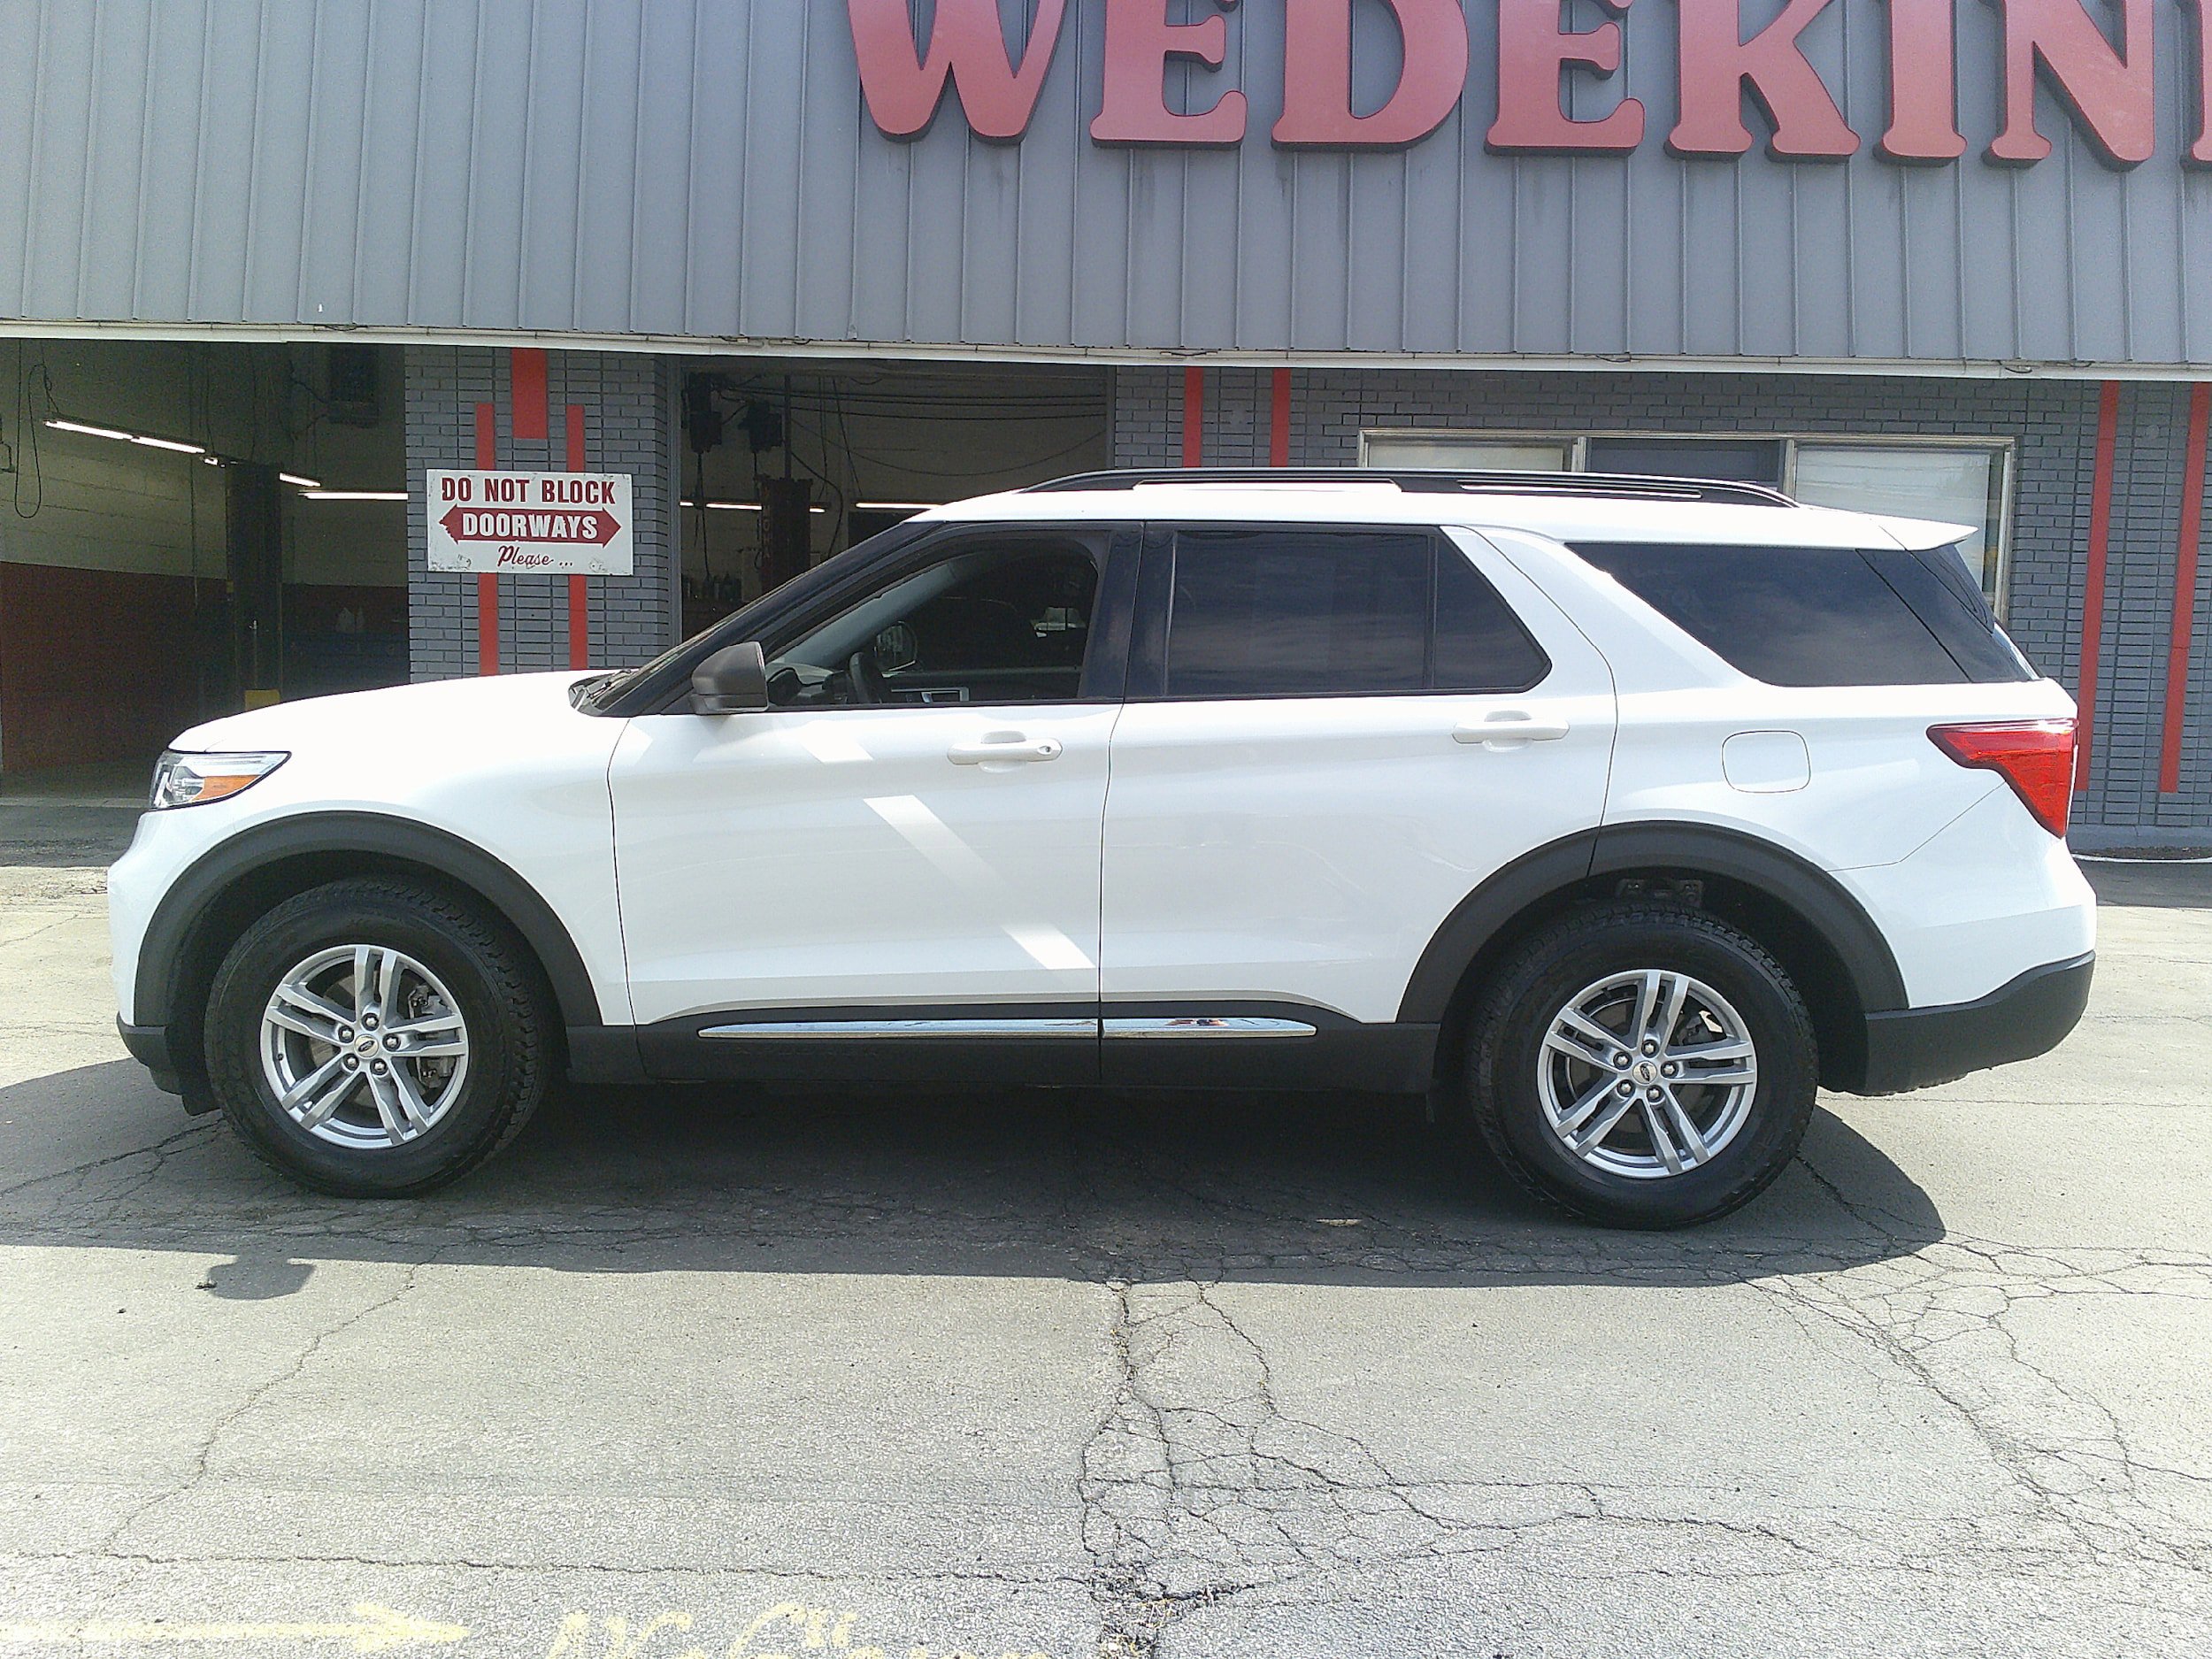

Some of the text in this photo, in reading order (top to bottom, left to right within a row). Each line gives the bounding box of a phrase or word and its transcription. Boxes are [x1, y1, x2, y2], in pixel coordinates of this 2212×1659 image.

[848, 0, 2212, 165] WEDEKIN
[442, 477, 616, 504] DO NOT BLOCK
[461, 511, 598, 540] DOORWAYS
[496, 545, 554, 567] Please
